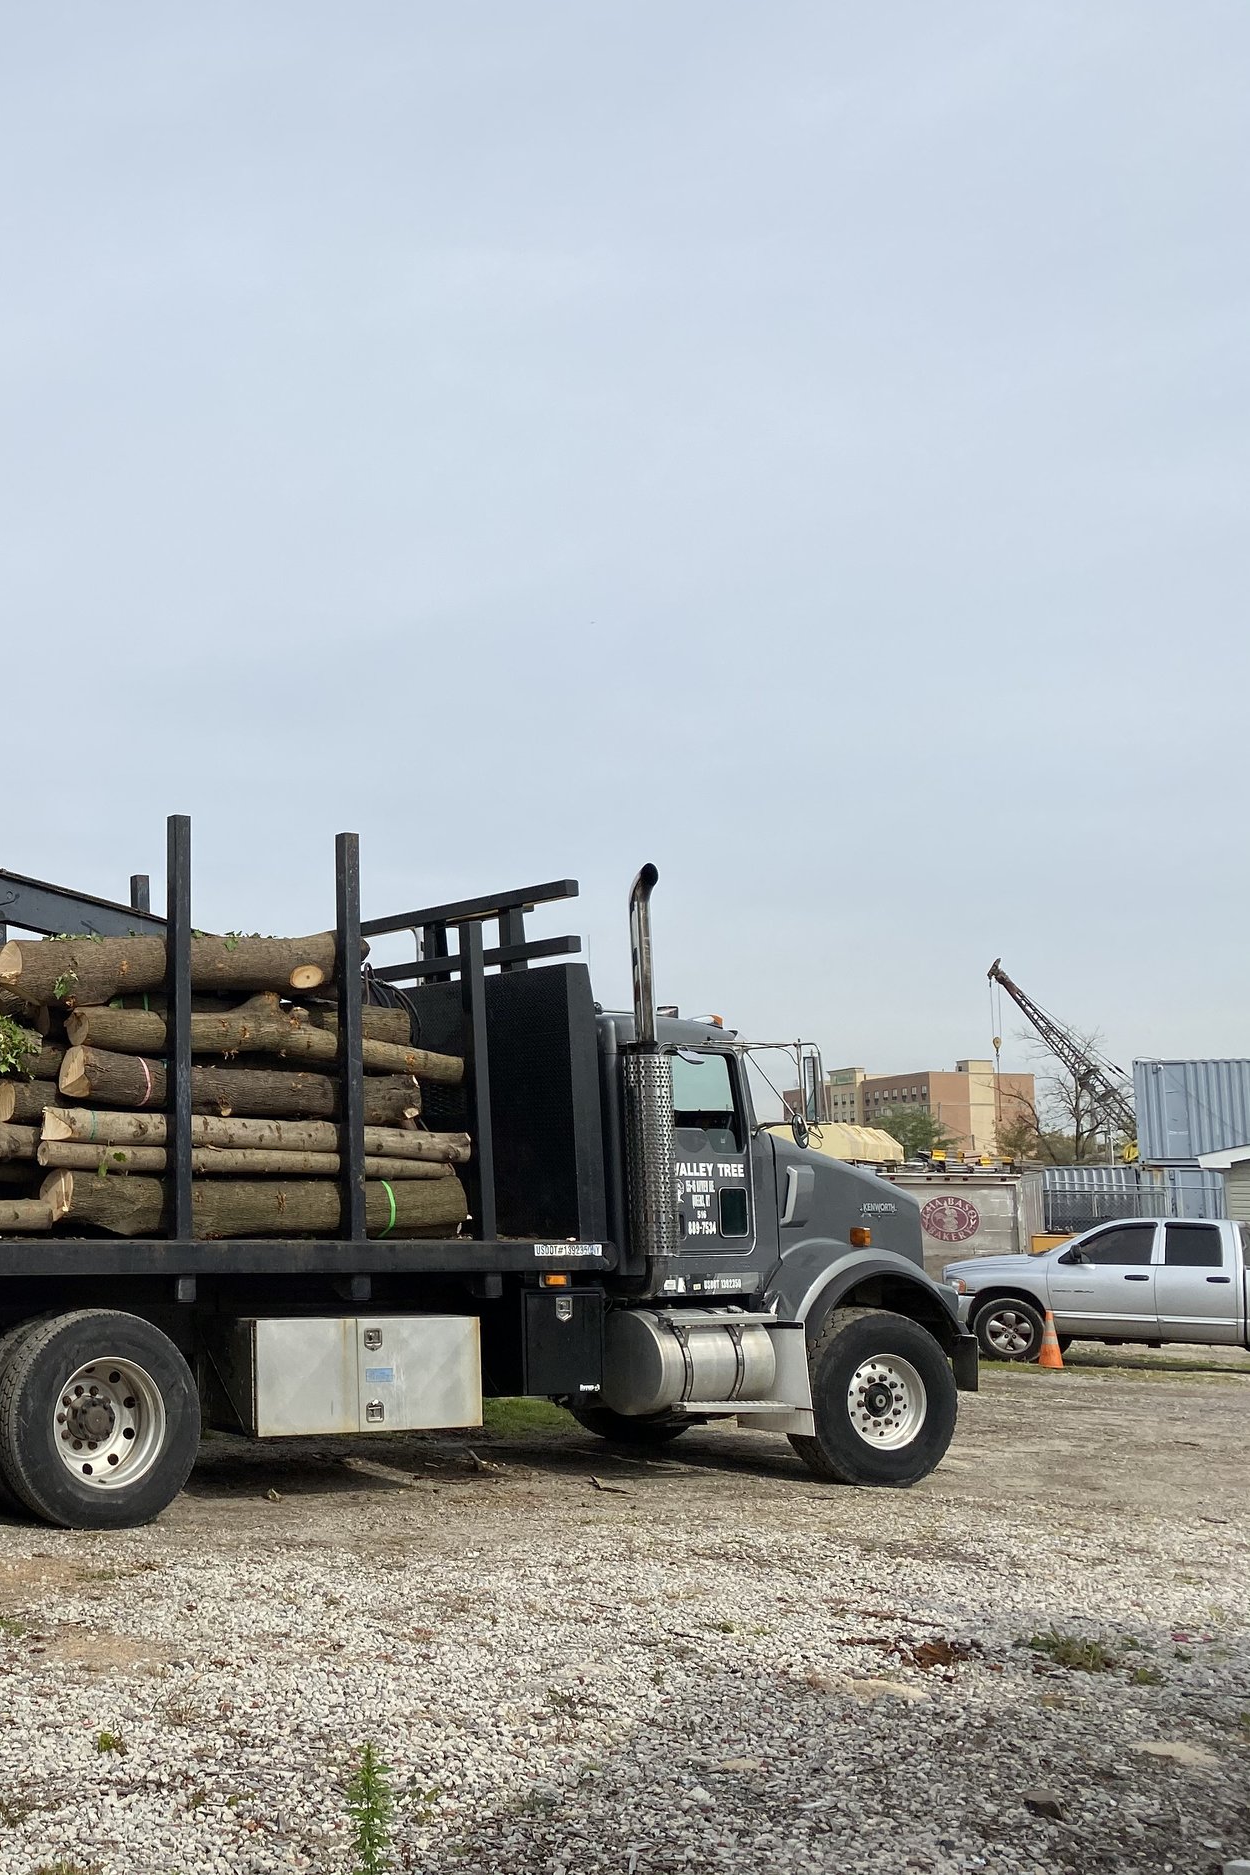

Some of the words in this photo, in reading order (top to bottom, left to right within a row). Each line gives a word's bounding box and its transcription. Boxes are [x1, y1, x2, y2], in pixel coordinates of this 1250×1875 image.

[675, 1163, 714, 1177] VALLEY
[717, 1163, 745, 1178] TREE
[862, 1202, 897, 1212] KENWORTH
[928, 1226, 975, 1241] BAKERY
